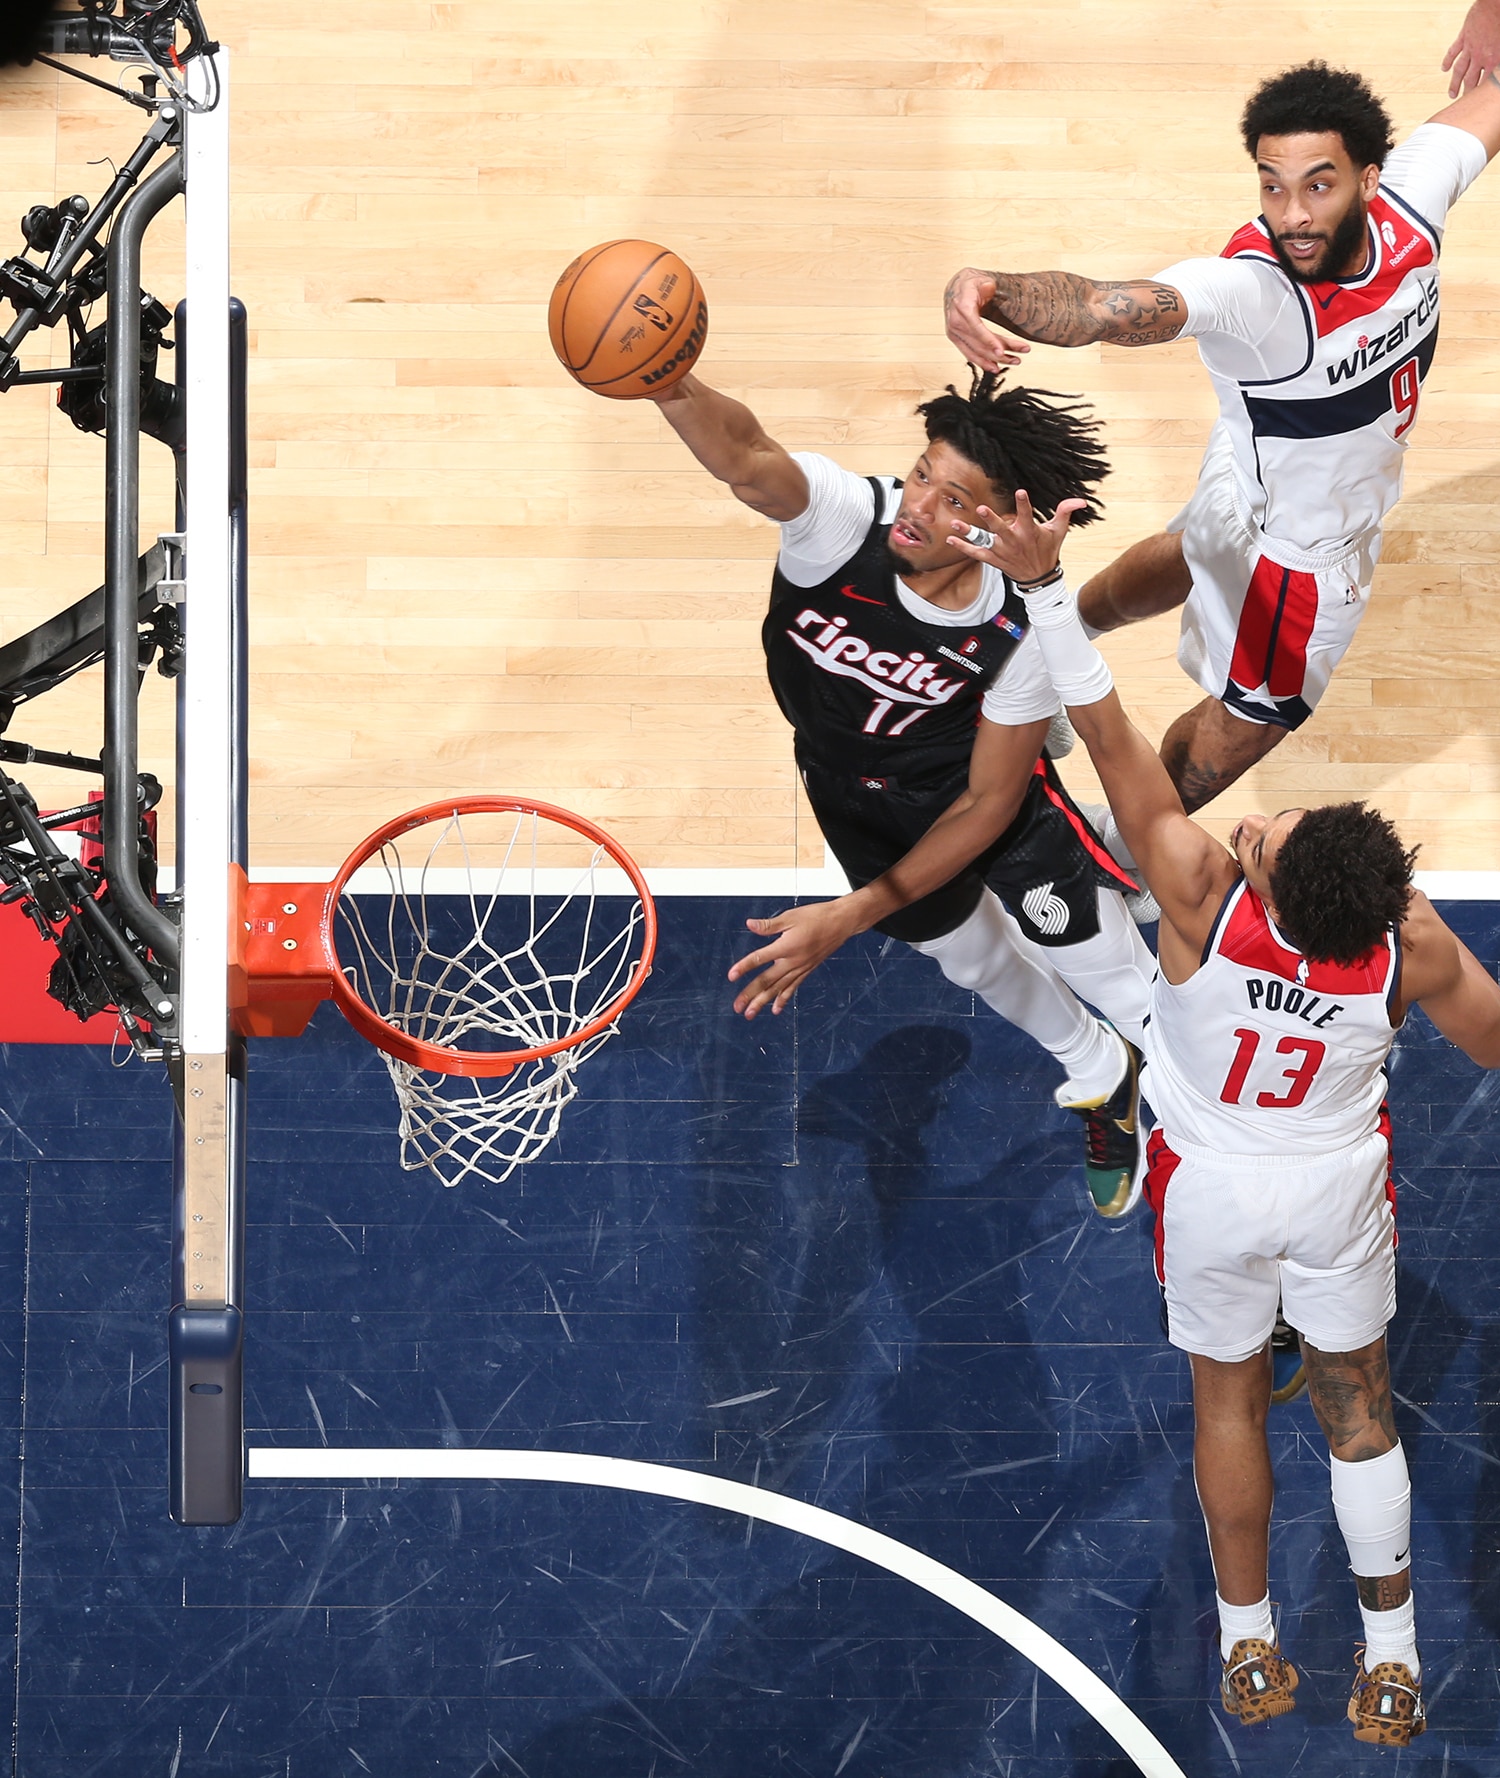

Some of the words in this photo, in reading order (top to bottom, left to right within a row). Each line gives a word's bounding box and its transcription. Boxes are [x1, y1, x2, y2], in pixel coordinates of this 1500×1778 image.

[1388, 234, 1421, 268] Robinhood
[1326, 274, 1439, 386] wizards
[1389, 355, 1419, 439] 9
[787, 608, 968, 706] ripcity
[936, 645, 984, 676] BRIGHTSIDE
[39, 807, 82, 824] Manfrotto
[1246, 978, 1345, 1029] POOLE
[1219, 1027, 1327, 1108] 13
